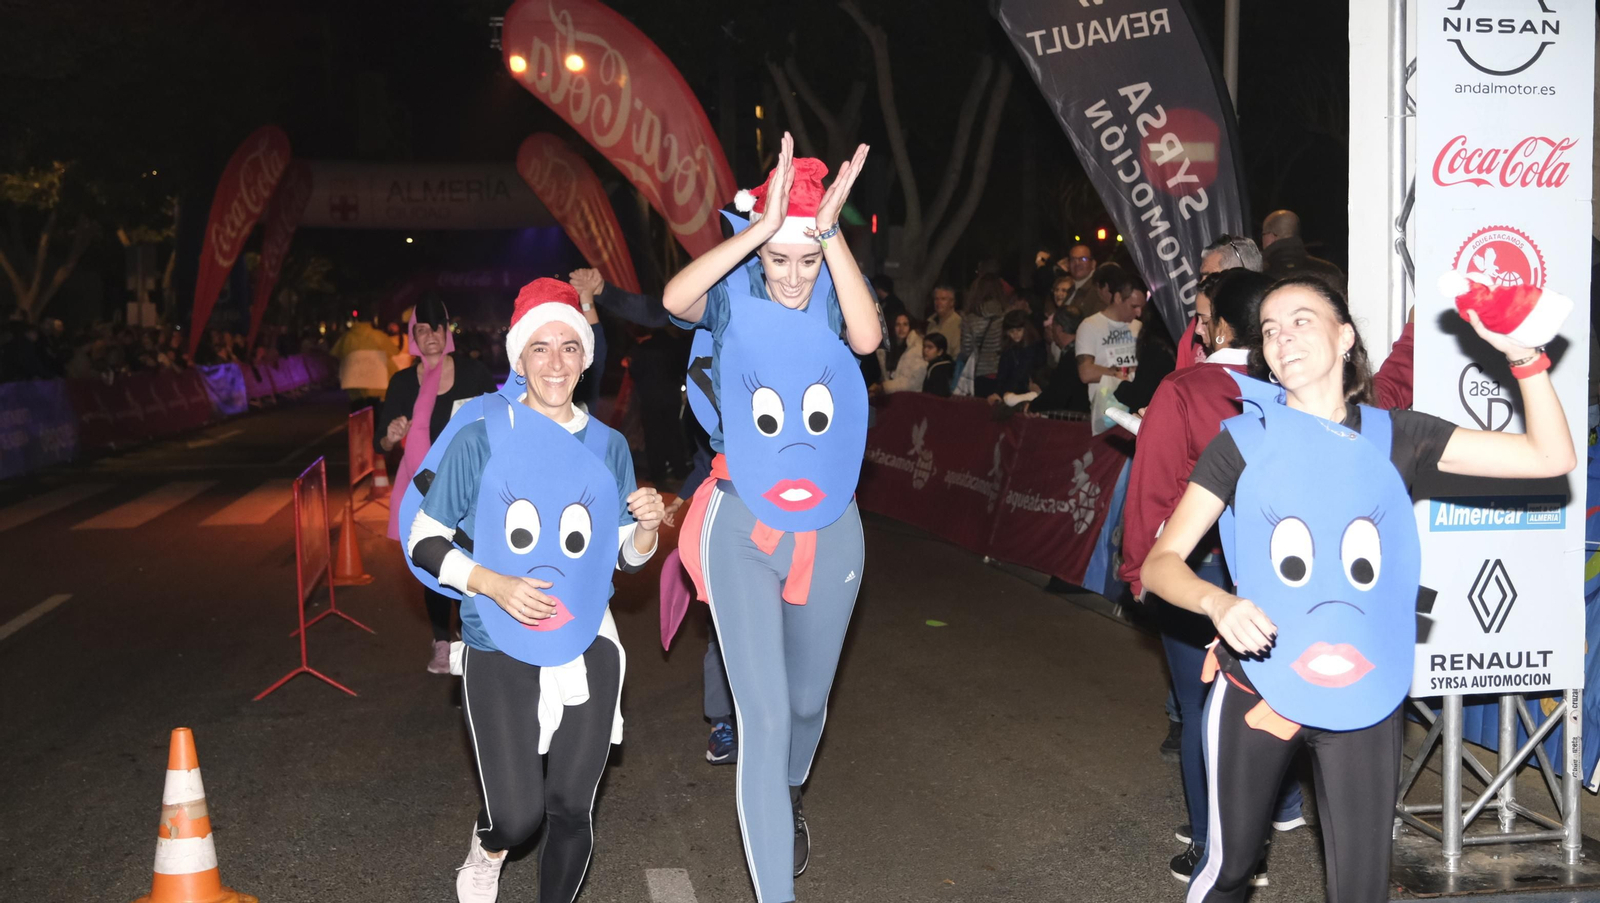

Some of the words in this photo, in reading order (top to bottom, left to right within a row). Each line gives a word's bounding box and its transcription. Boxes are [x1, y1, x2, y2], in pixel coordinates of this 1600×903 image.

[1443, 17, 1560, 36] NISSAN
[1454, 82, 1556, 97] andalmotor.es
[1432, 134, 1580, 189] Coca-Cola
[386, 175, 511, 204] ALMERÍA
[1471, 233, 1526, 251] AQUEATACAMOS
[1434, 501, 1525, 527] Almericar
[1529, 513, 1559, 523] ALMERIA
[1430, 650, 1554, 672] RENAULT
[1430, 676, 1467, 690] SYRSA
[1471, 673, 1551, 688] AUTOMOCION
